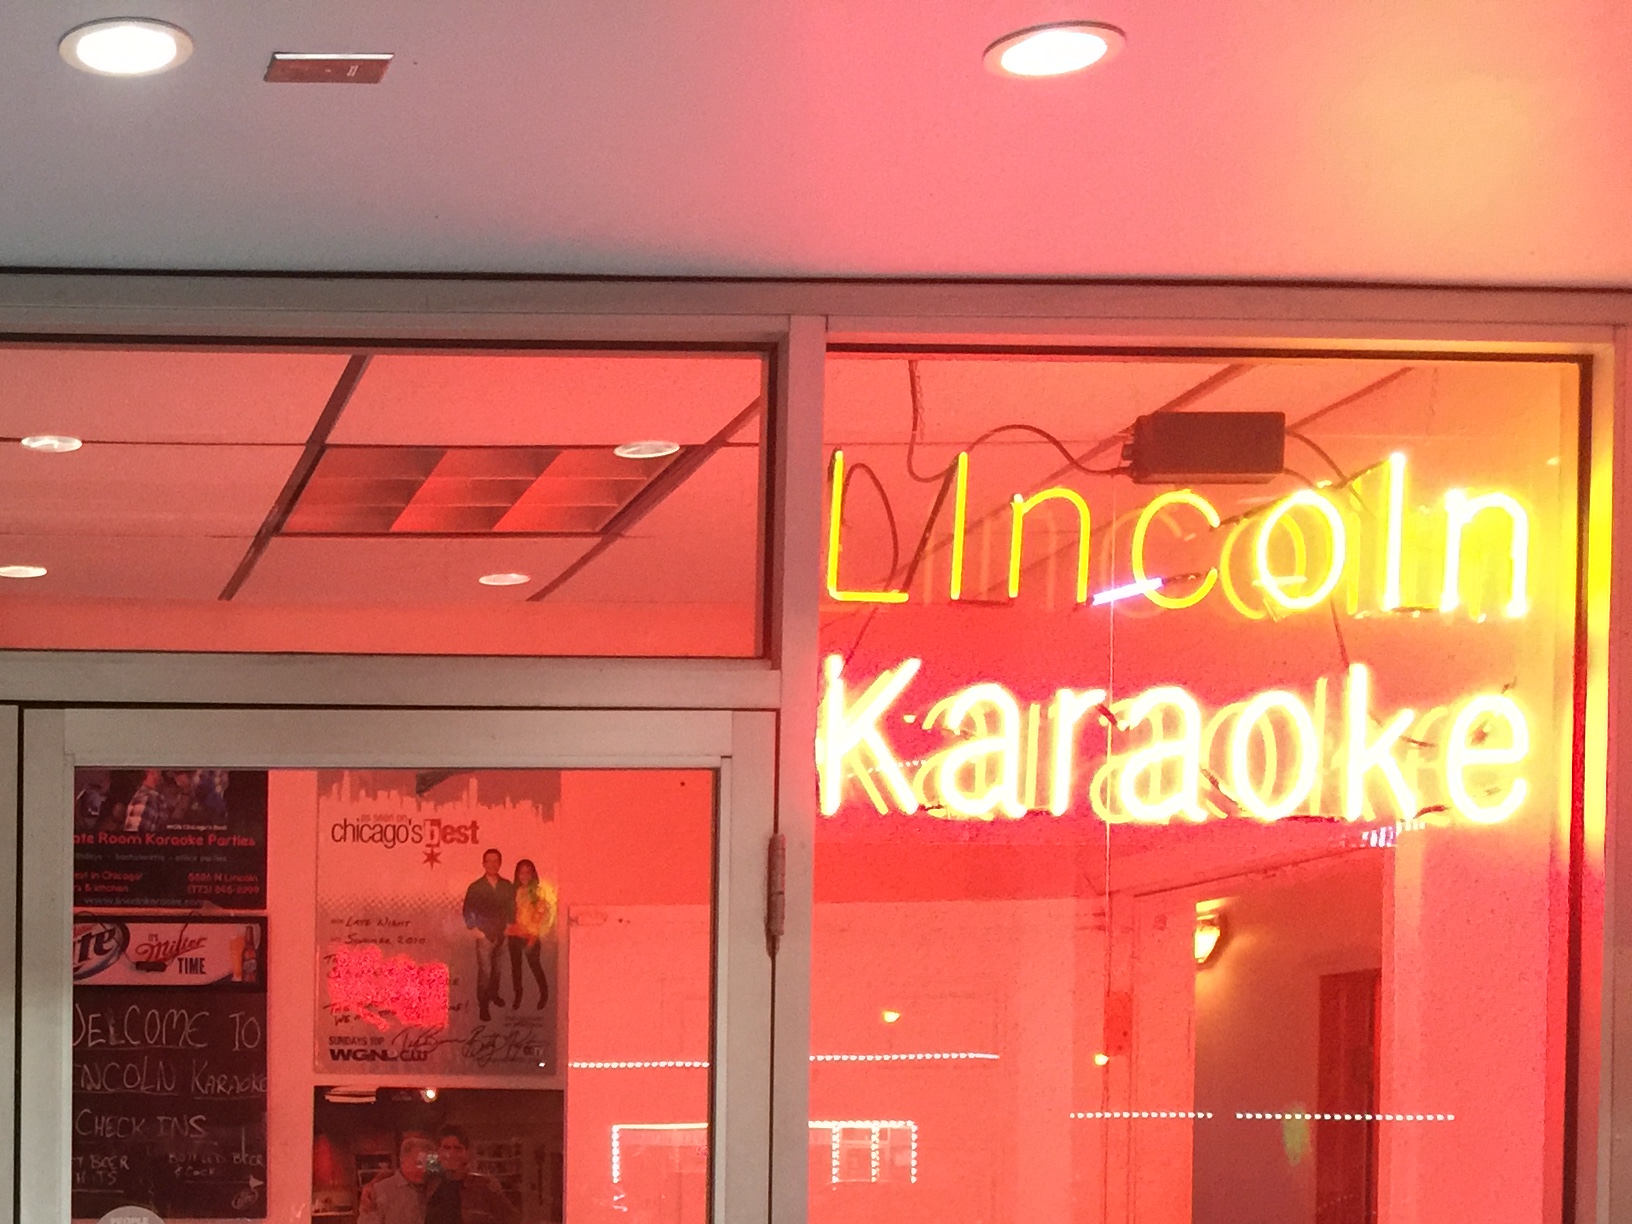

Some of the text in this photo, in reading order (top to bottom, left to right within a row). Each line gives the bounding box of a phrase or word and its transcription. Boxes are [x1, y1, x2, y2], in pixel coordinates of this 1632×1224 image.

[818, 653, 1532, 825] Karaoke
[74, 833, 255, 846] ate Room Karaoke Parties
[332, 818, 423, 849] chicago's
[136, 937, 207, 962] Miller
[397, 935, 426, 944] 2010
[178, 958, 206, 974] TIME
[230, 1012, 260, 1051] TO
[329, 1036, 368, 1046] SUNDAYS
[75, 1109, 145, 1138] CHECK
